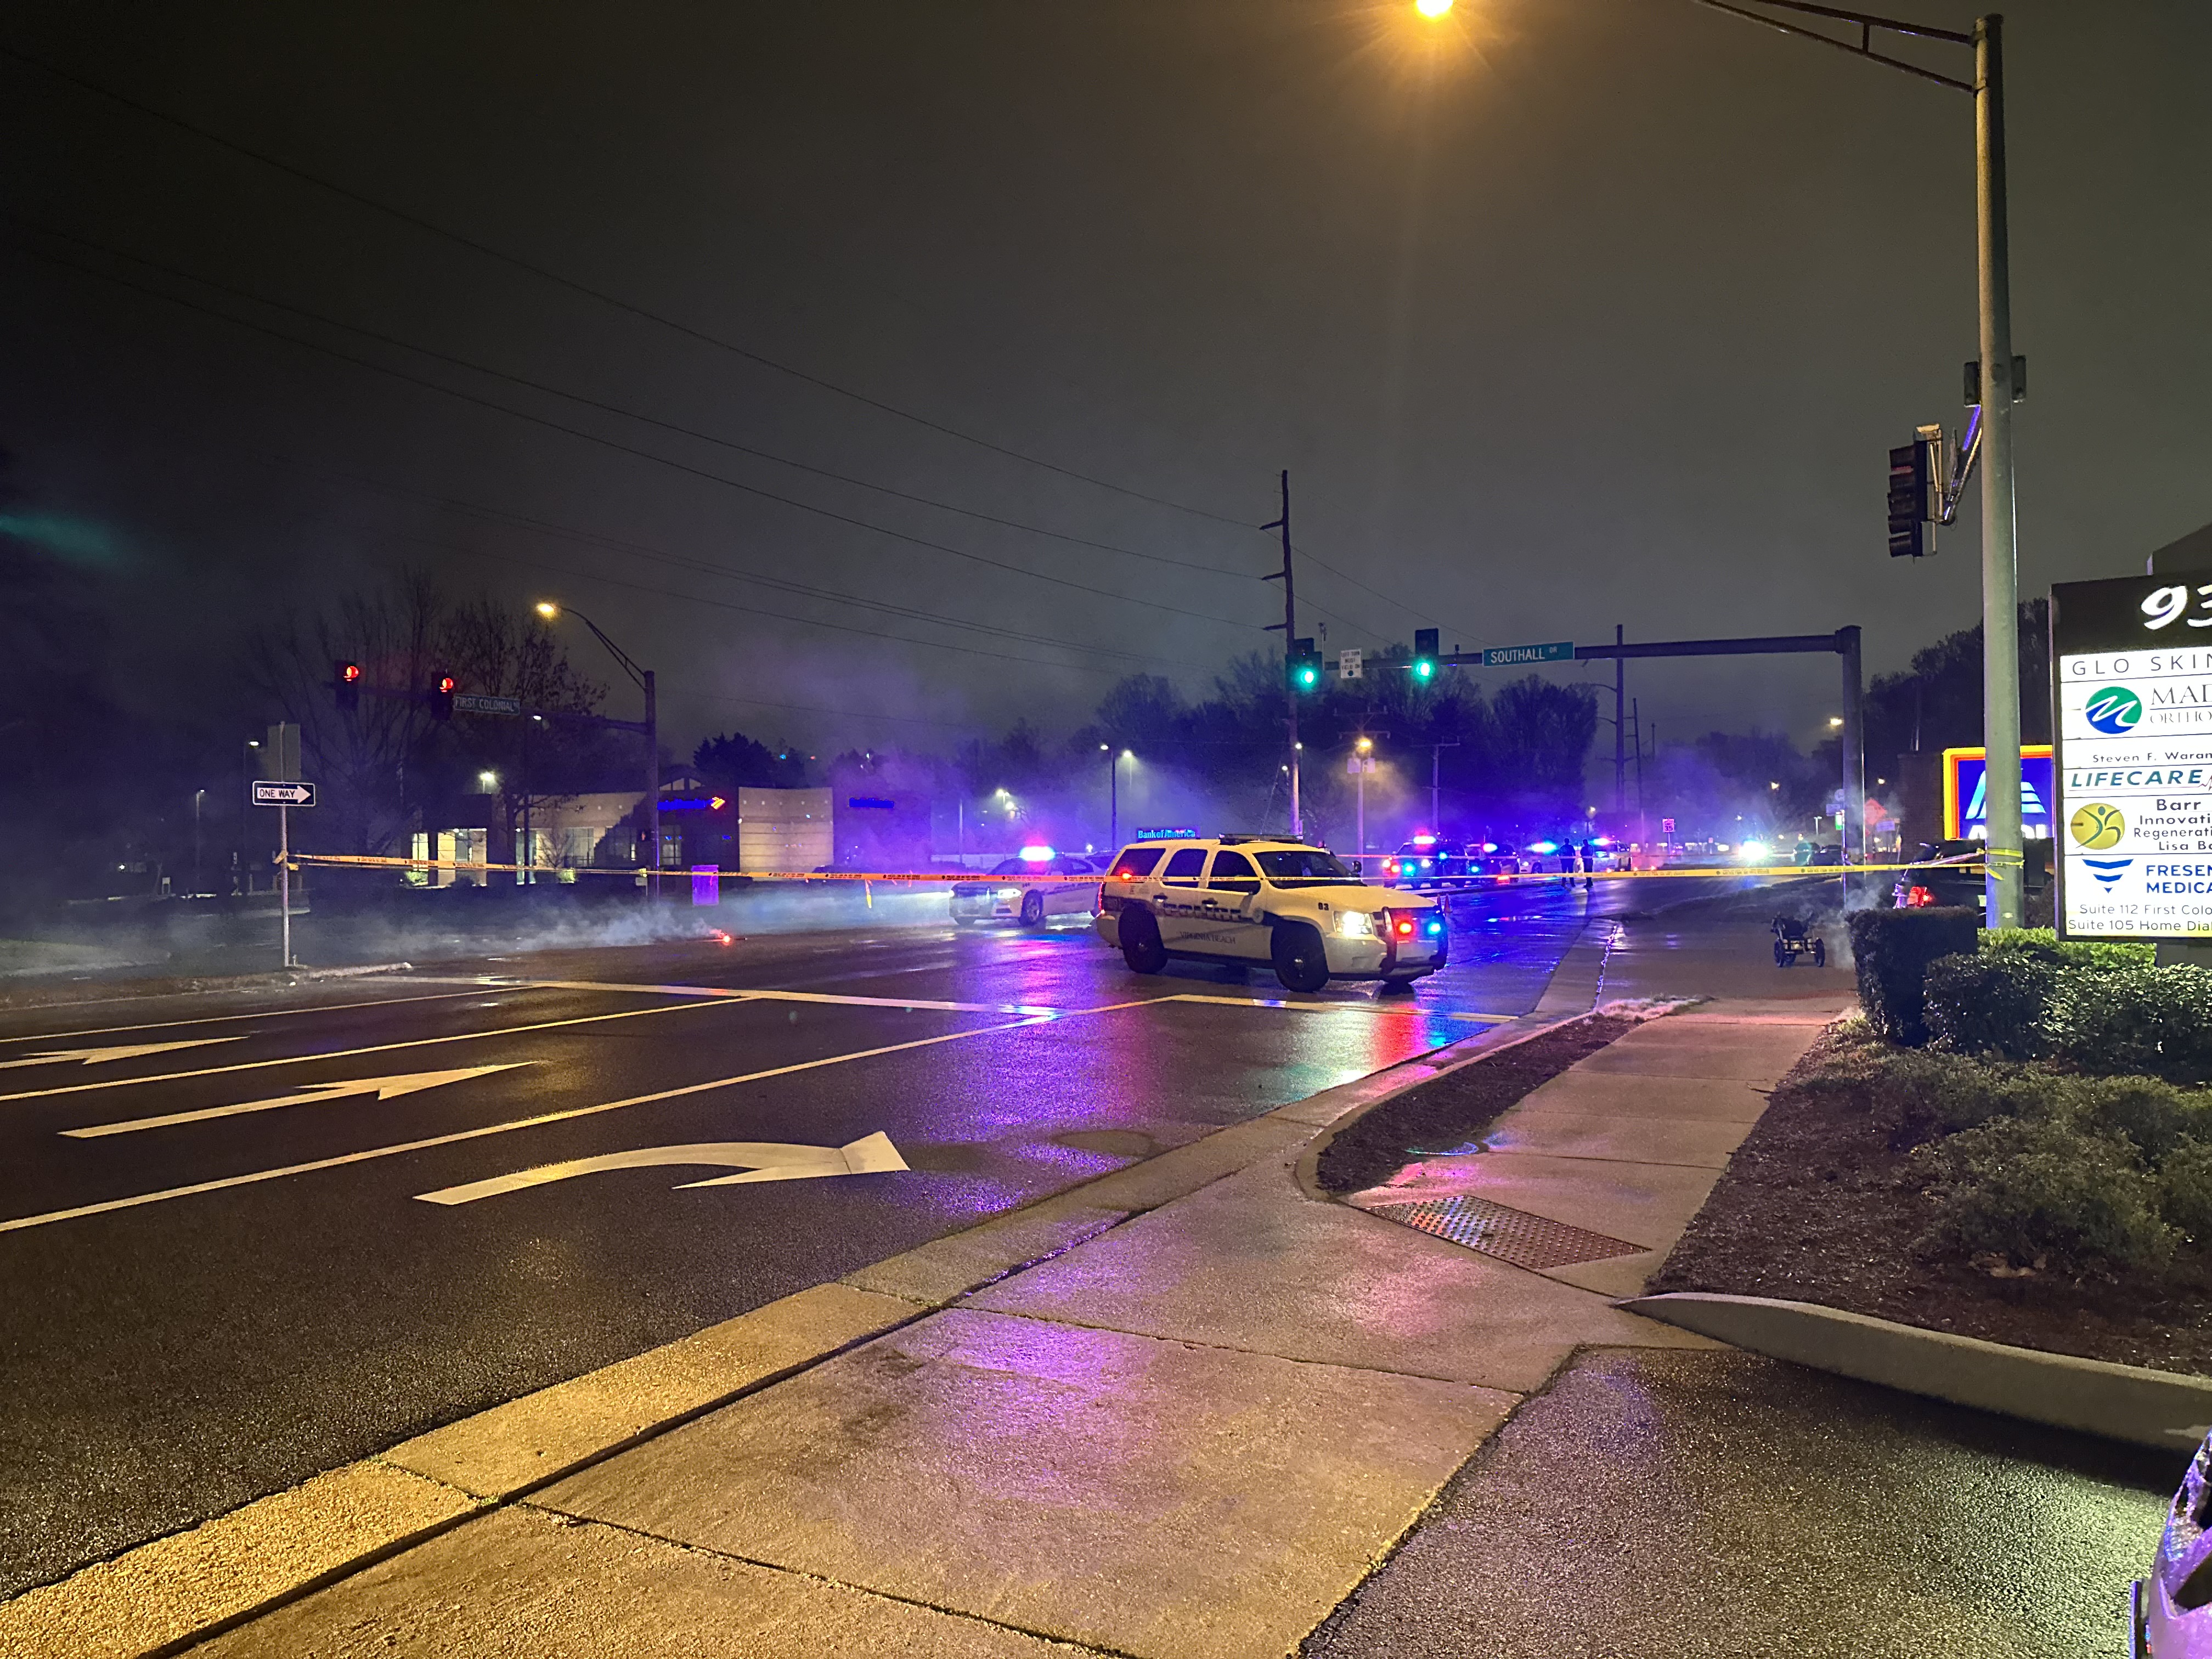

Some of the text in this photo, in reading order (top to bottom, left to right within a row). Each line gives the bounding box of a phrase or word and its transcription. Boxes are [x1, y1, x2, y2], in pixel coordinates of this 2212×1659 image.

[1491, 648, 1545, 663] SOUTHALL
[2072, 659, 2129, 675] GLO
[455, 697, 476, 708] FIRST
[479, 698, 515, 712] COLONIAL
[2147, 753, 2157, 761] F.
[2071, 769, 2203, 787] LIFECARE
[259, 789, 295, 798] ONE WAY
[2157, 799, 2201, 811] Barr
[2140, 814, 2211, 825] Innovati
[1137, 829, 1196, 838] Bank of America
[1968, 825, 2046, 839] AI
[2159, 841, 2188, 850] Lisa
[2080, 904, 2212, 915] Suite 112 First Colo
[2068, 920, 2104, 930] Suite
[2109, 921, 2134, 930] 105
[2140, 921, 2181, 931] Home
[1212, 934, 1236, 944] BEACH
